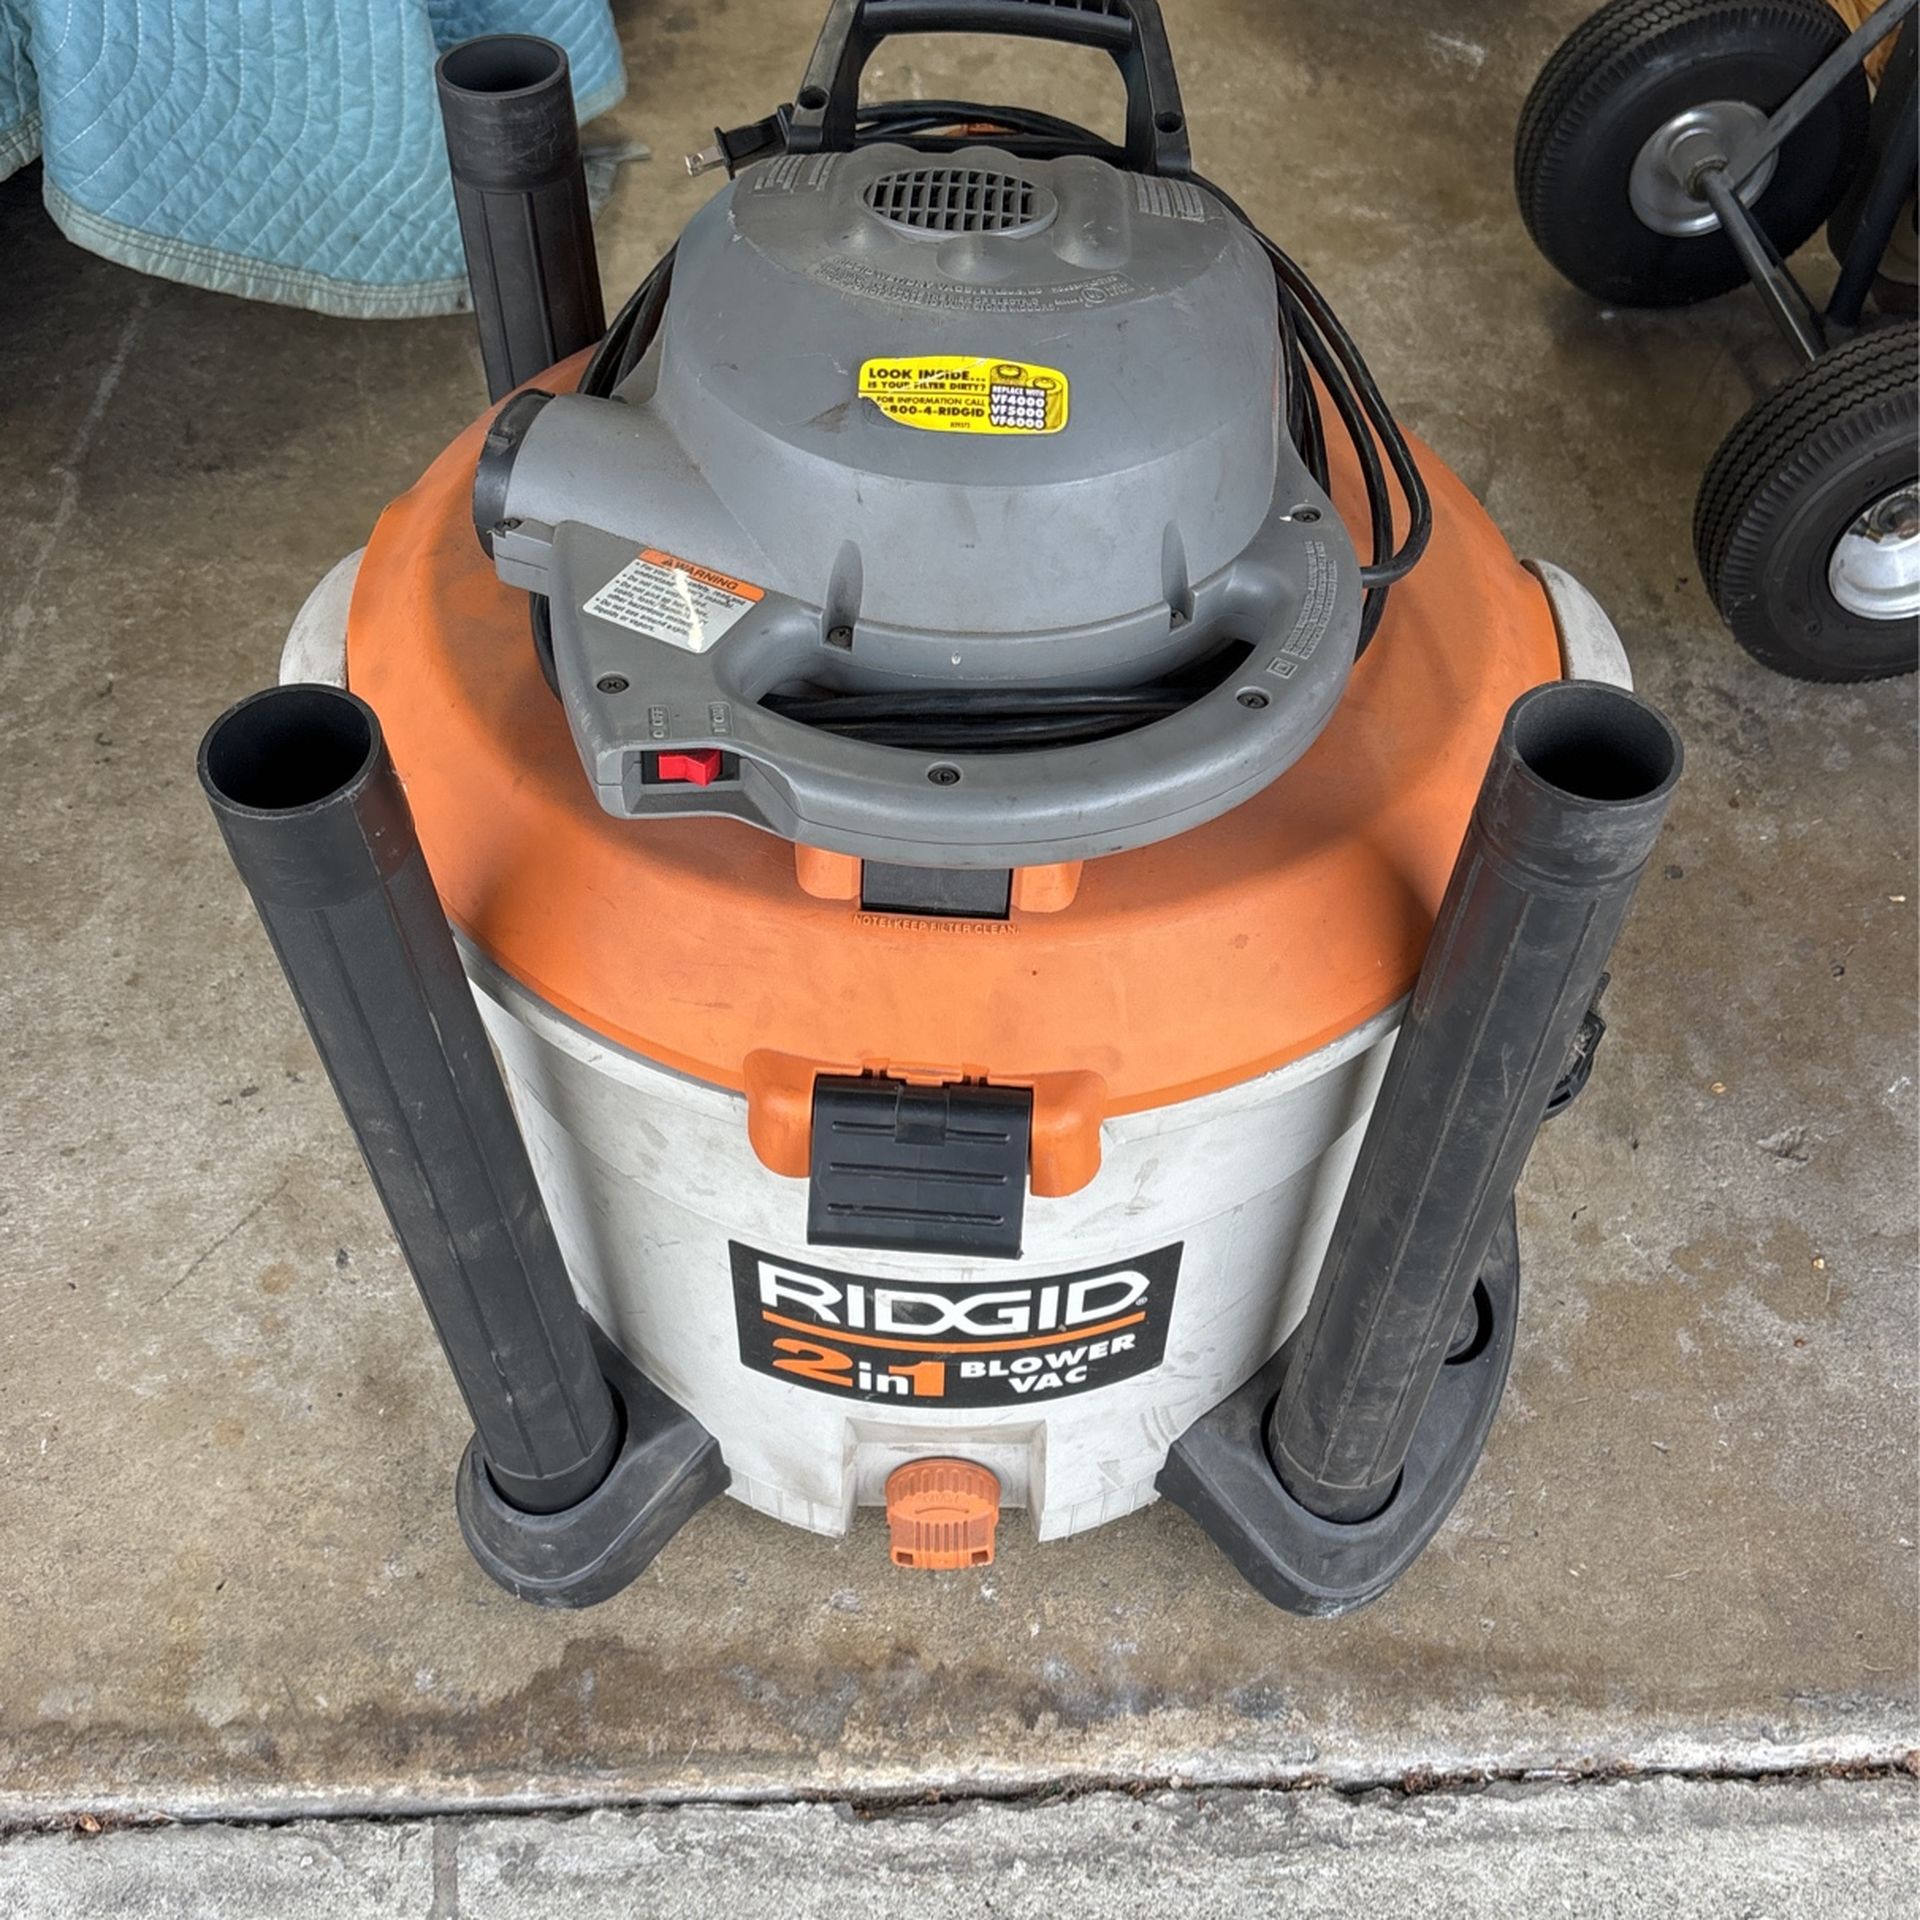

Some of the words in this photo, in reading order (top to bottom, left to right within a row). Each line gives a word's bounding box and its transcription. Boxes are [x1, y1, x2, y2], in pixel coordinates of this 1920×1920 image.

[869, 368, 912, 379] LOOK
[868, 381, 877, 389] IS
[950, 383, 986, 391] DIRTY?
[991, 385, 1024, 395] REPLACE
[877, 396, 894, 404] FOR
[898, 396, 962, 406] INFORMATION
[964, 398, 986, 406] CALL
[991, 394, 1045, 408] VF4000
[991, 404, 1045, 419] VF5000
[990, 415, 1045, 429] VF6000
[675, 561, 738, 590] WARNING
[894, 918, 927, 932] KEEP
[929, 921, 971, 934] FILTER
[975, 923, 1020, 935] CLEAN.
[758, 1260, 1150, 1337] RIDGID
[772, 1337, 945, 1397] 2in1
[960, 1333, 1136, 1379] BLOWER
[1009, 1366, 1087, 1394] VAC
